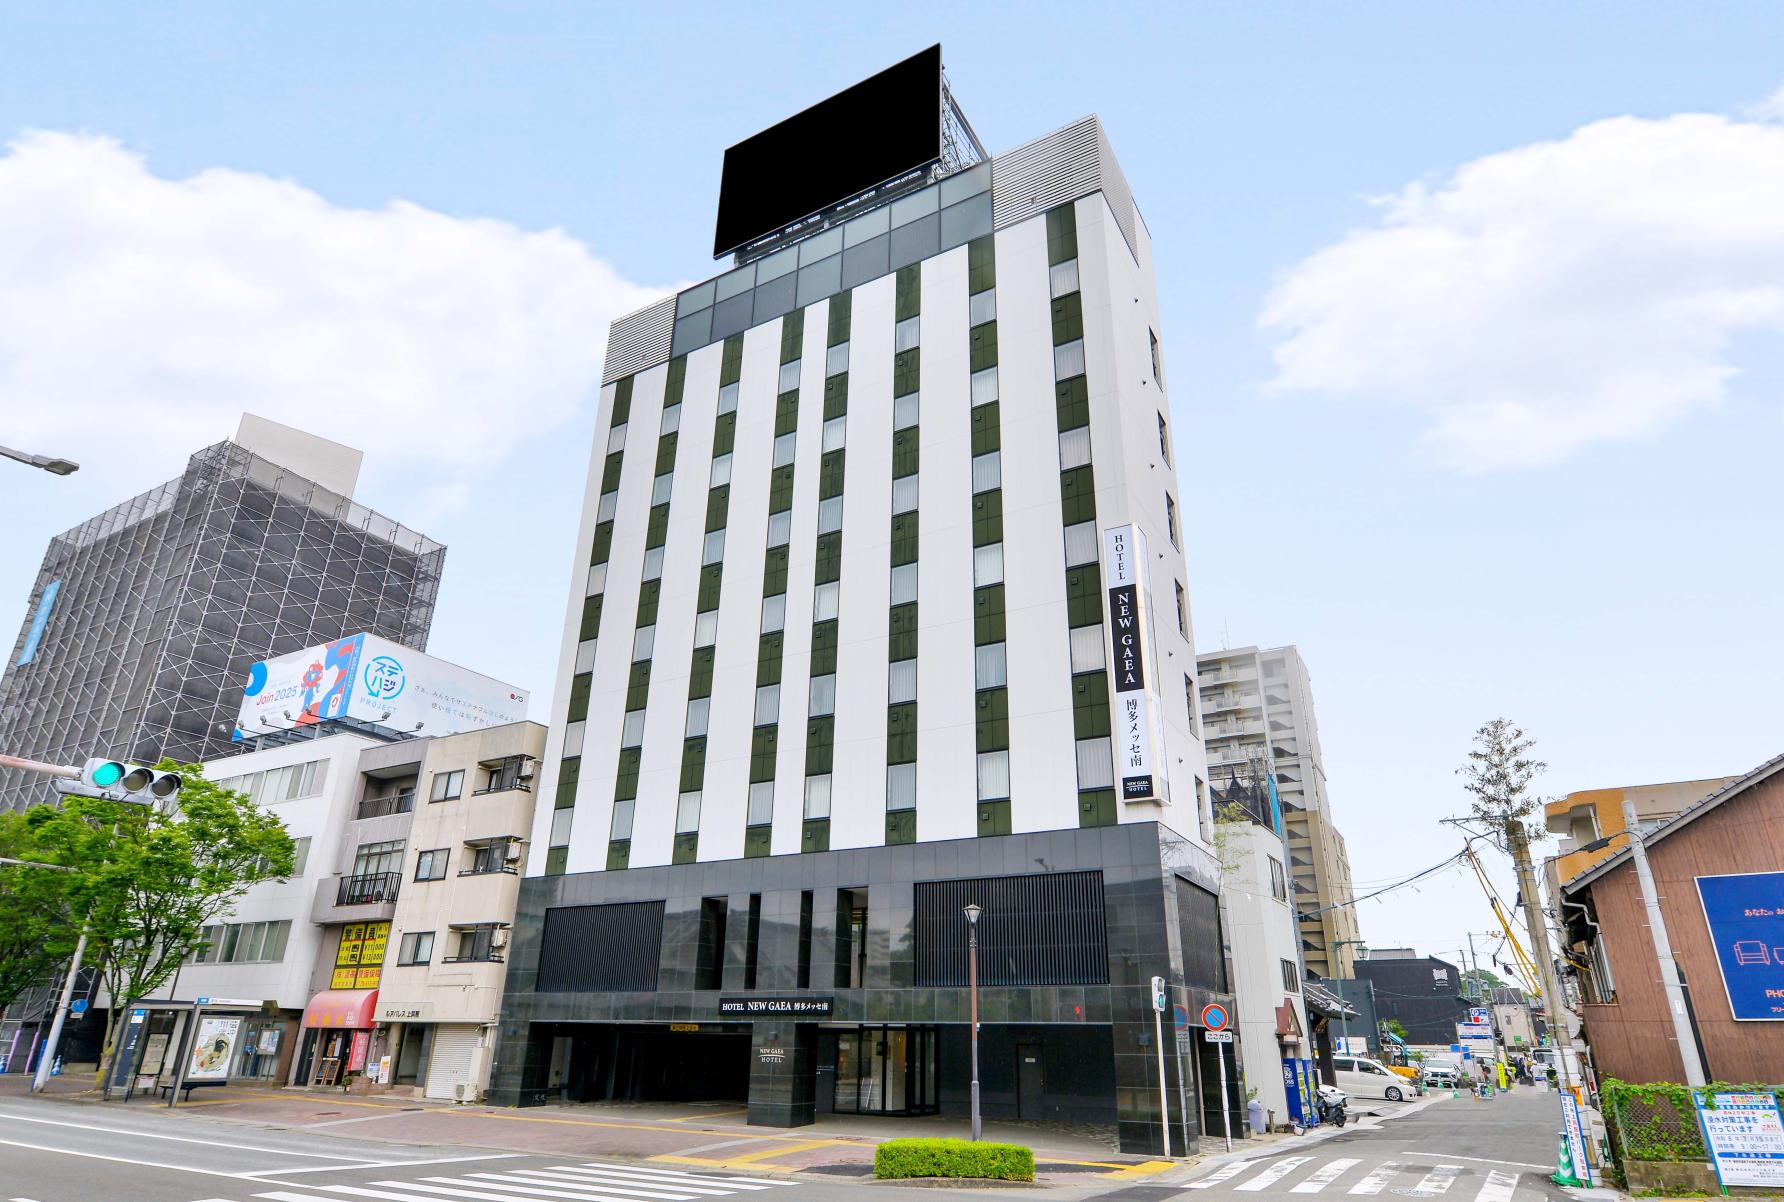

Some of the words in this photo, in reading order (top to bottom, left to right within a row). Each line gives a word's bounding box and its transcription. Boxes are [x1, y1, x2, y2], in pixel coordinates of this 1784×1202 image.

[1114, 534, 1126, 581] HOTEL
[1117, 592, 1133, 629] NEW
[1121, 634, 1136, 685] GAEA
[375, 661, 400, 678] ステ
[371, 675, 397, 691] ハジ
[256, 693, 275, 706] Join
[274, 687, 297, 702] 2025
[359, 696, 399, 713] PROJECT
[1126, 699, 1142, 767] 博多メッセ南
[722, 1003, 745, 1011] HOTEL
[747, 1001, 768, 1011] NEW
[768, 1001, 791, 1011] GAEA
[794, 1002, 828, 1011] 博多メッセ南
[1207, 1033, 1231, 1041] ここから
[1709, 1124, 1754, 1133] 行っています
